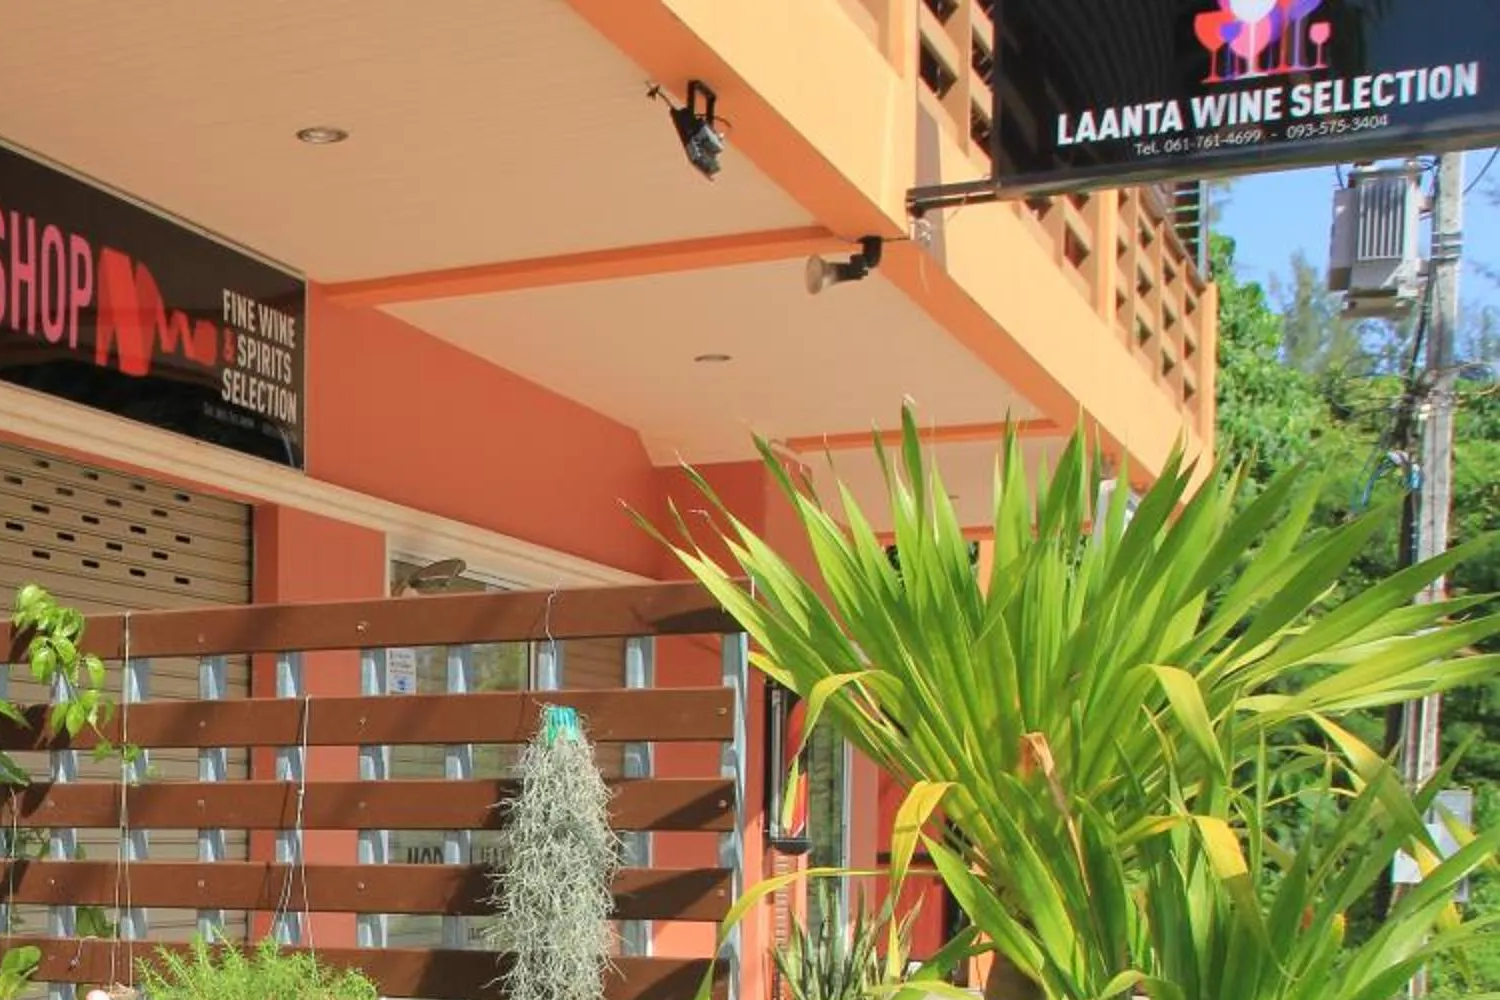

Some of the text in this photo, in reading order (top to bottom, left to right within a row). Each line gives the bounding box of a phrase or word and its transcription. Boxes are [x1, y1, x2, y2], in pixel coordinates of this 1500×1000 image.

[1057, 60, 1480, 146] LAANTA WINE SELECTION
[1134, 142, 1160, 156] Tel.
[1163, 128, 1262, 154] 061-761-4699
[1286, 112, 1389, 140] 093-575-3404
[222, 287, 297, 349] FINE WINE
[237, 333, 293, 385] SPIRITS
[221, 367, 298, 425] SELECTION
